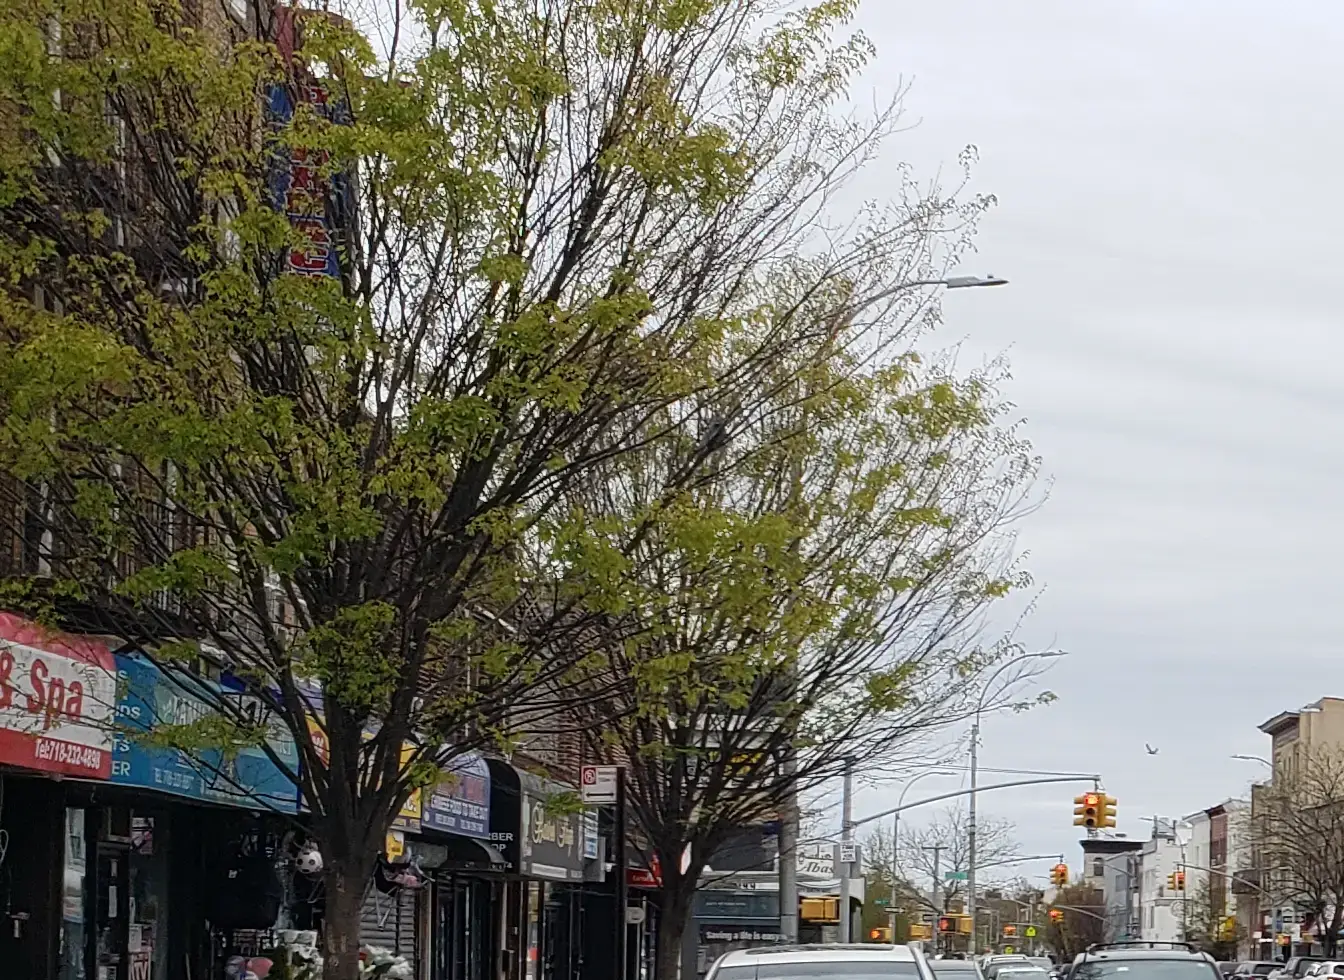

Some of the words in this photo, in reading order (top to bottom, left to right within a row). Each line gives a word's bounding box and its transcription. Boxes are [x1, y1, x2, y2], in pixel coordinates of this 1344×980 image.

[26, 658, 83, 732] Spa
[488, 832, 514, 841] BER
[706, 930, 733, 941] Saving
